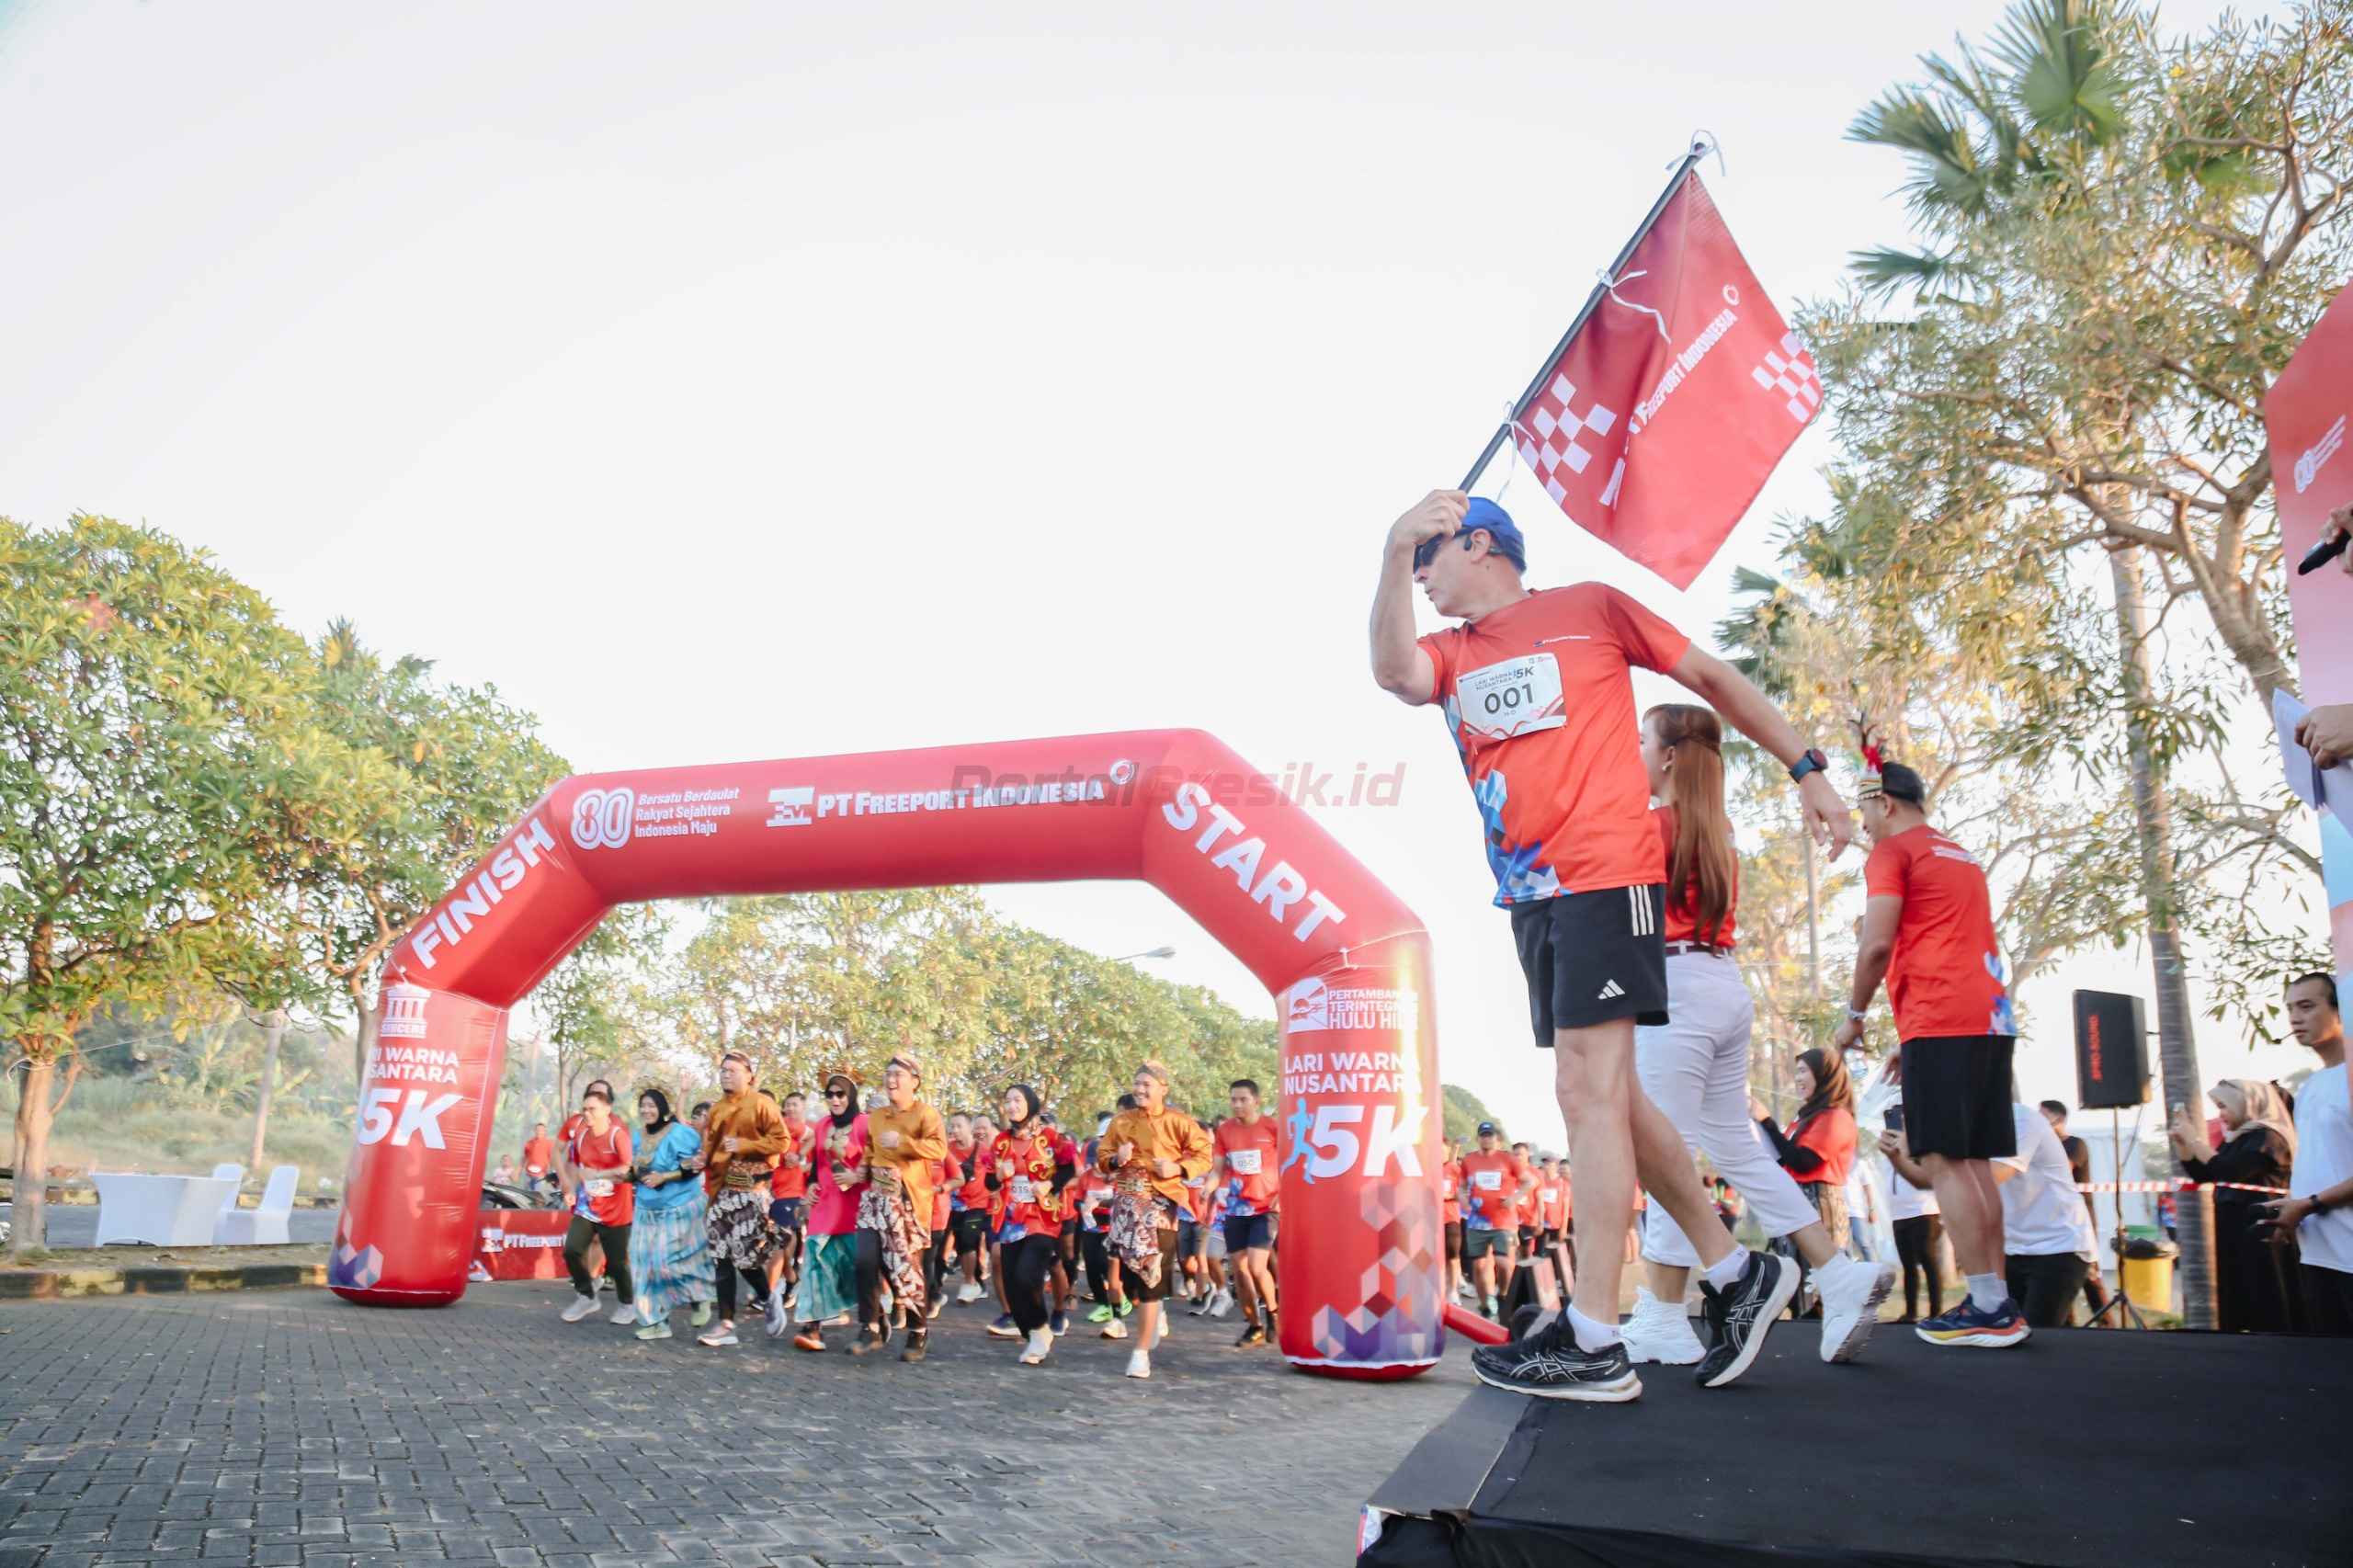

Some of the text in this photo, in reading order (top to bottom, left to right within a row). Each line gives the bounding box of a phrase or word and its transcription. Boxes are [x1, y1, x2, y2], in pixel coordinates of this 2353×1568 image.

[1484, 684, 1534, 714] 001
[638, 787, 740, 806] Bersatu Berdaulat
[817, 779, 1105, 818] PT FREEPORT INDONESIA
[571, 787, 634, 851] 80
[635, 803, 732, 823] Rakyat Sejahtera
[634, 820, 718, 838] Indonesia Maju
[1162, 782, 1347, 942] START
[411, 817, 556, 971] FINISH
[1329, 1012, 1376, 1029] HULU
[385, 1047, 460, 1068] WARNA
[1284, 1052, 1324, 1074] LARI
[369, 1062, 459, 1085] SANTARA
[358, 1087, 464, 1150] 5K
[1310, 1105, 1430, 1178] 5K
